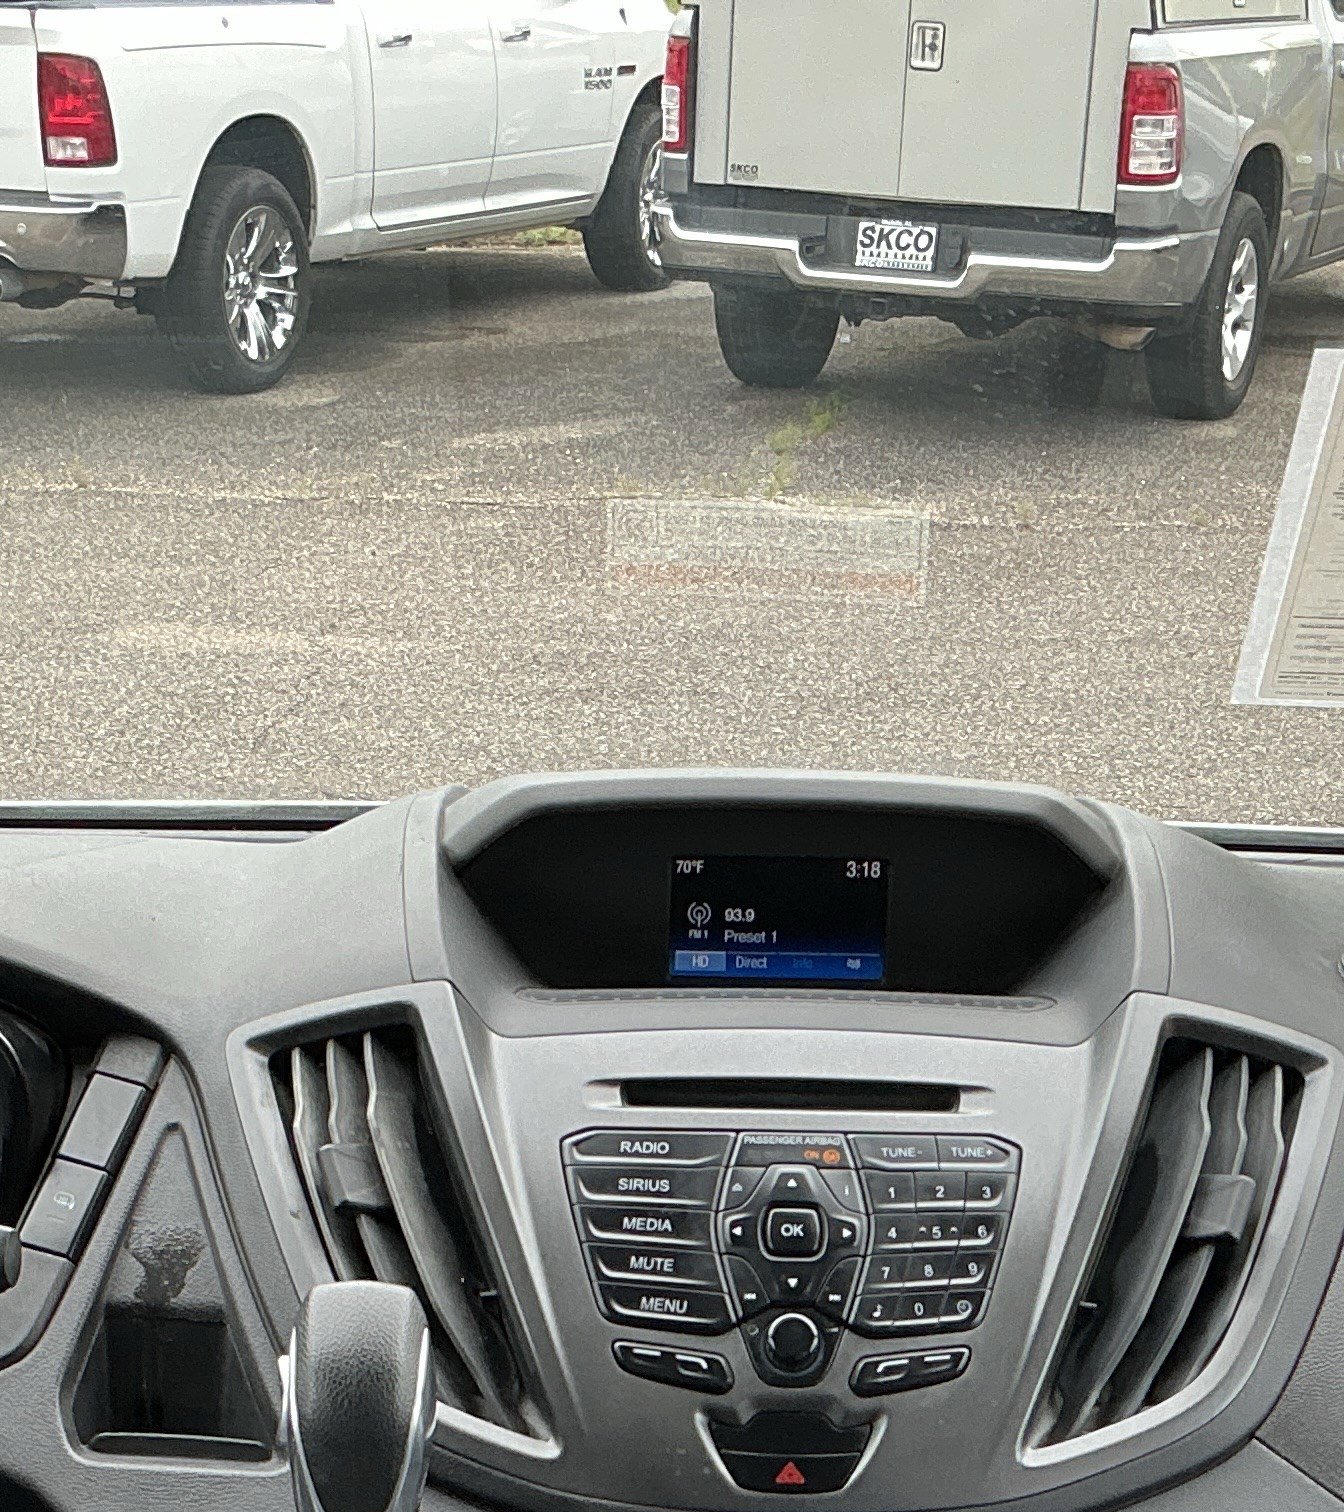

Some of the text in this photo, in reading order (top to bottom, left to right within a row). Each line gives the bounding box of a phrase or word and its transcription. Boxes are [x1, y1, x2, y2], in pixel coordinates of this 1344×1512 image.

[730, 163, 758, 174] SKCO
[859, 225, 934, 253] SKCO
[846, 861, 881, 878] 3:18
[724, 908, 755, 922] 93.9
[724, 930, 765, 943] Preset
[692, 955, 709, 968] HD
[736, 955, 767, 969] Direct
[620, 1140, 670, 1156] RADIO
[743, 1136, 841, 1146] PASSENGER AIRBAG
[618, 1177, 670, 1193] SIRIUS
[888, 1186, 896, 1199] 1
[935, 1185, 945, 1199] 2
[981, 1186, 992, 1199] 3
[622, 1216, 672, 1233] MEDIA
[780, 1223, 805, 1238] OK
[977, 1224, 989, 1239] 6
[887, 1226, 898, 1240] 4
[932, 1225, 943, 1240] 5
[630, 1255, 674, 1273] MUTE
[924, 1263, 935, 1279] 8
[967, 1261, 979, 1277] 9
[881, 1266, 891, 1280] 7
[639, 1296, 689, 1315] MENU
[914, 1301, 925, 1317] 0
